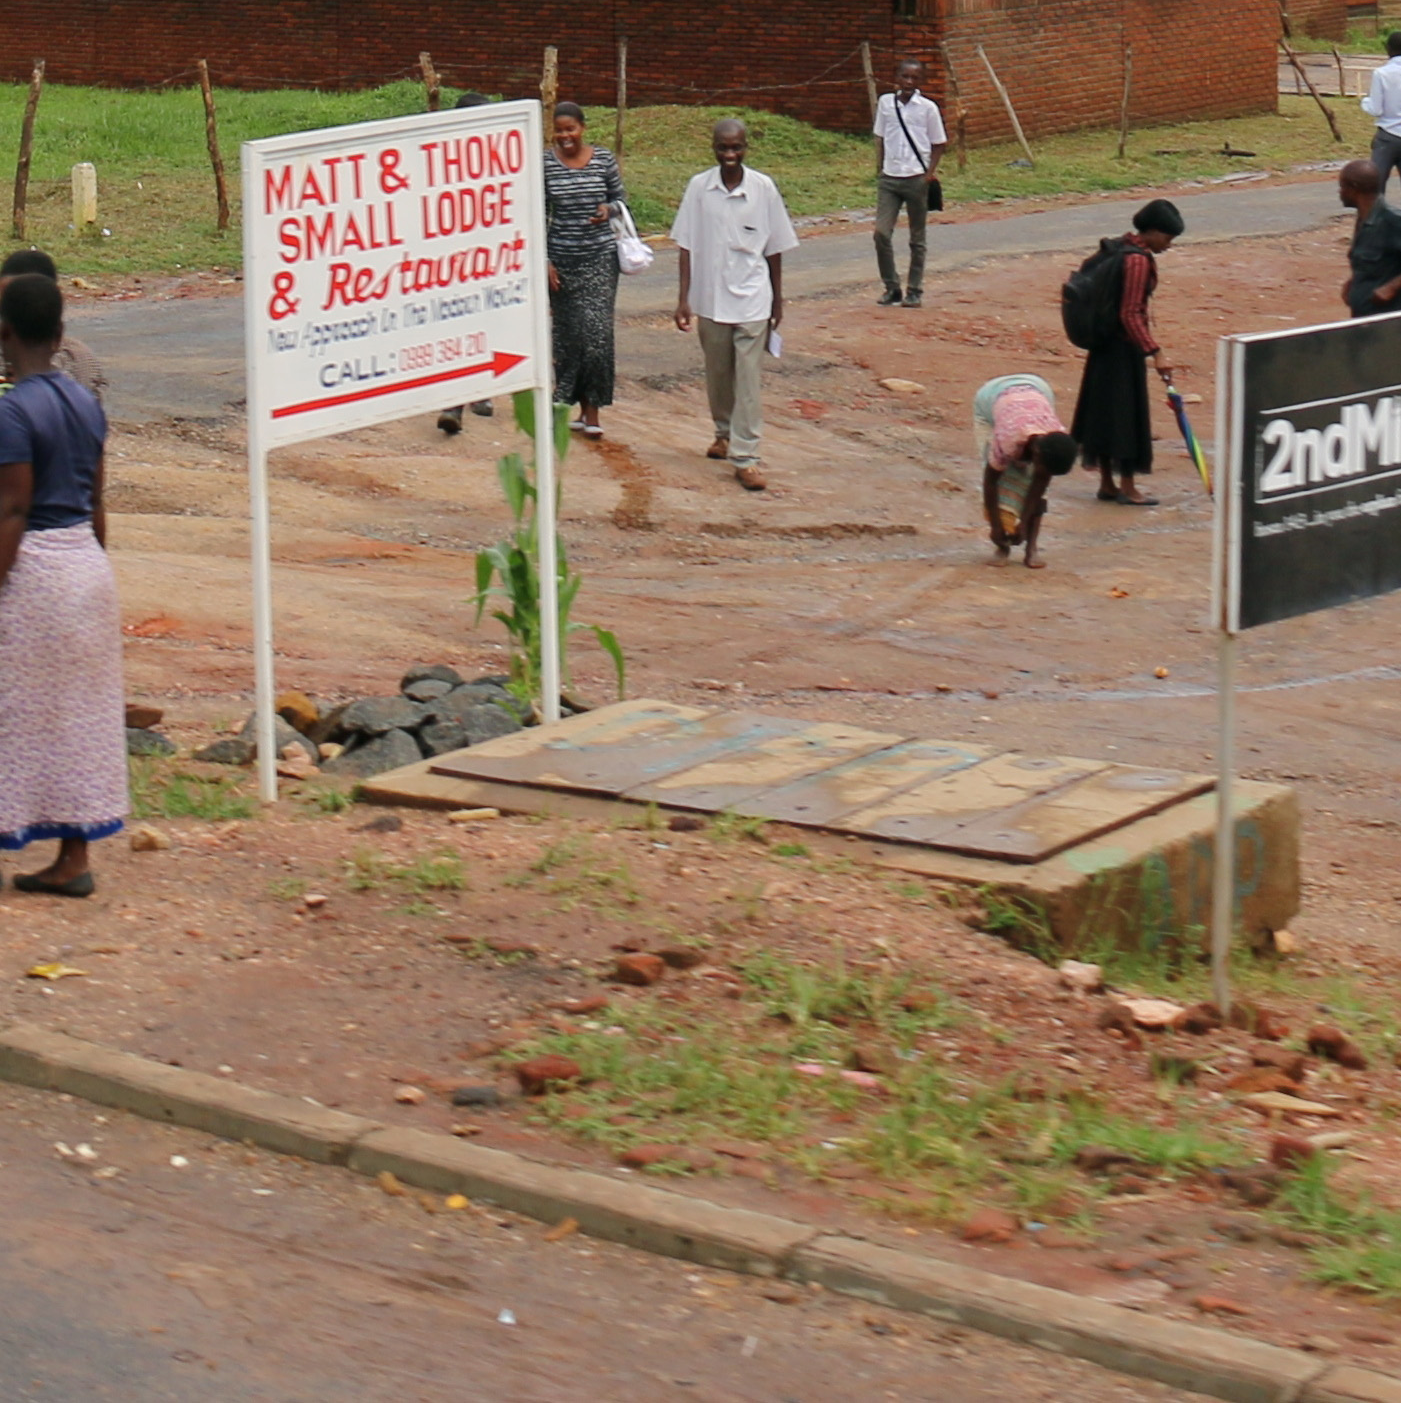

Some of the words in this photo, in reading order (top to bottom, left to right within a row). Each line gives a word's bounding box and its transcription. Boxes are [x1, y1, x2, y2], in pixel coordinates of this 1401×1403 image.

[264, 153, 367, 215] MATT
[378, 147, 411, 195] &
[420, 128, 525, 188] THOKO
[279, 201, 405, 264] SMALL
[420, 181, 514, 240] LODGE
[268, 270, 301, 321] &
[320, 230, 526, 311] Restaurant
[266, 328, 299, 355] New
[301, 310, 378, 359] Approach
